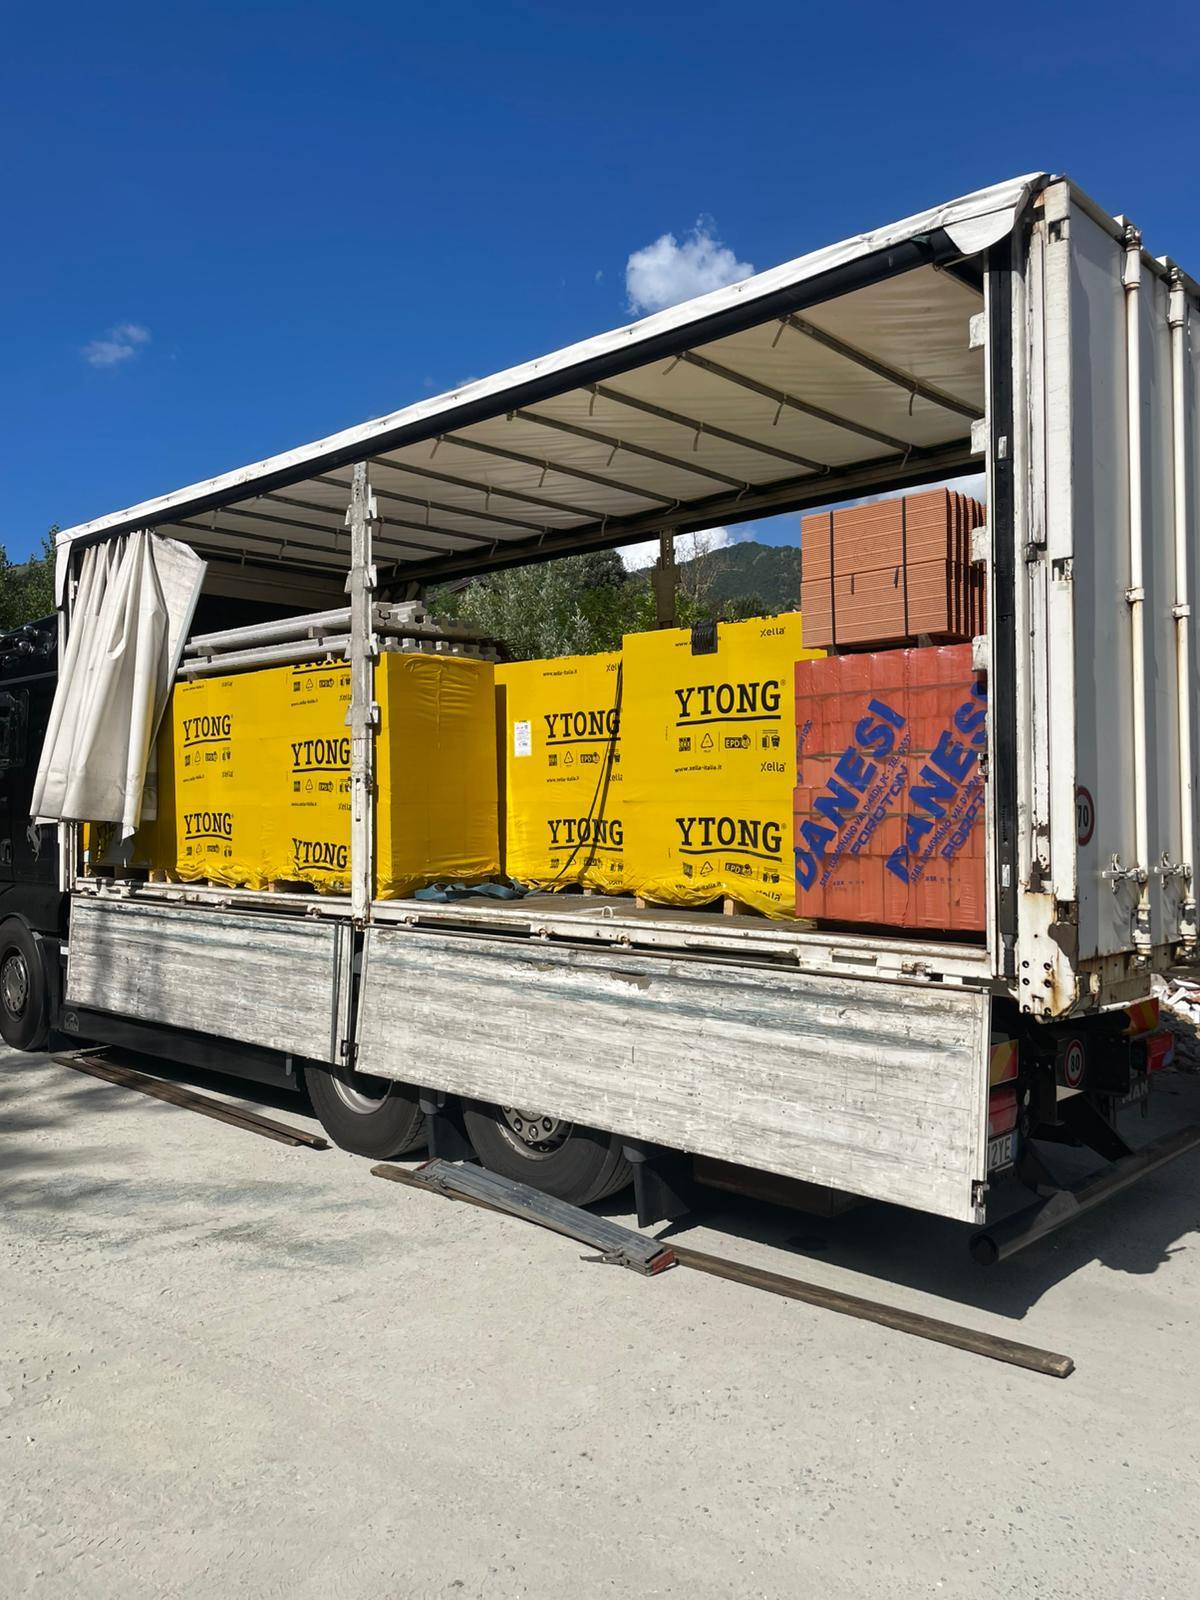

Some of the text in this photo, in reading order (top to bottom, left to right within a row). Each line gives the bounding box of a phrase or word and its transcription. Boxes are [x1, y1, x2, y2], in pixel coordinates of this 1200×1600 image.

[675, 679, 781, 718] YTONG
[182, 714, 232, 741] YTONG
[543, 708, 621, 739] YTONG
[291, 739, 351, 767] YTONG
[760, 762, 785, 773] Xella
[795, 699, 906, 892] DANESI
[184, 812, 232, 835] YTONG
[941, 789, 987, 860] POROT
[1077, 804, 1089, 828] 70
[547, 818, 623, 846] YTONG
[675, 817, 782, 855] YTONG
[292, 837, 348, 868] YTONG
[1070, 1054, 1081, 1073] 80
